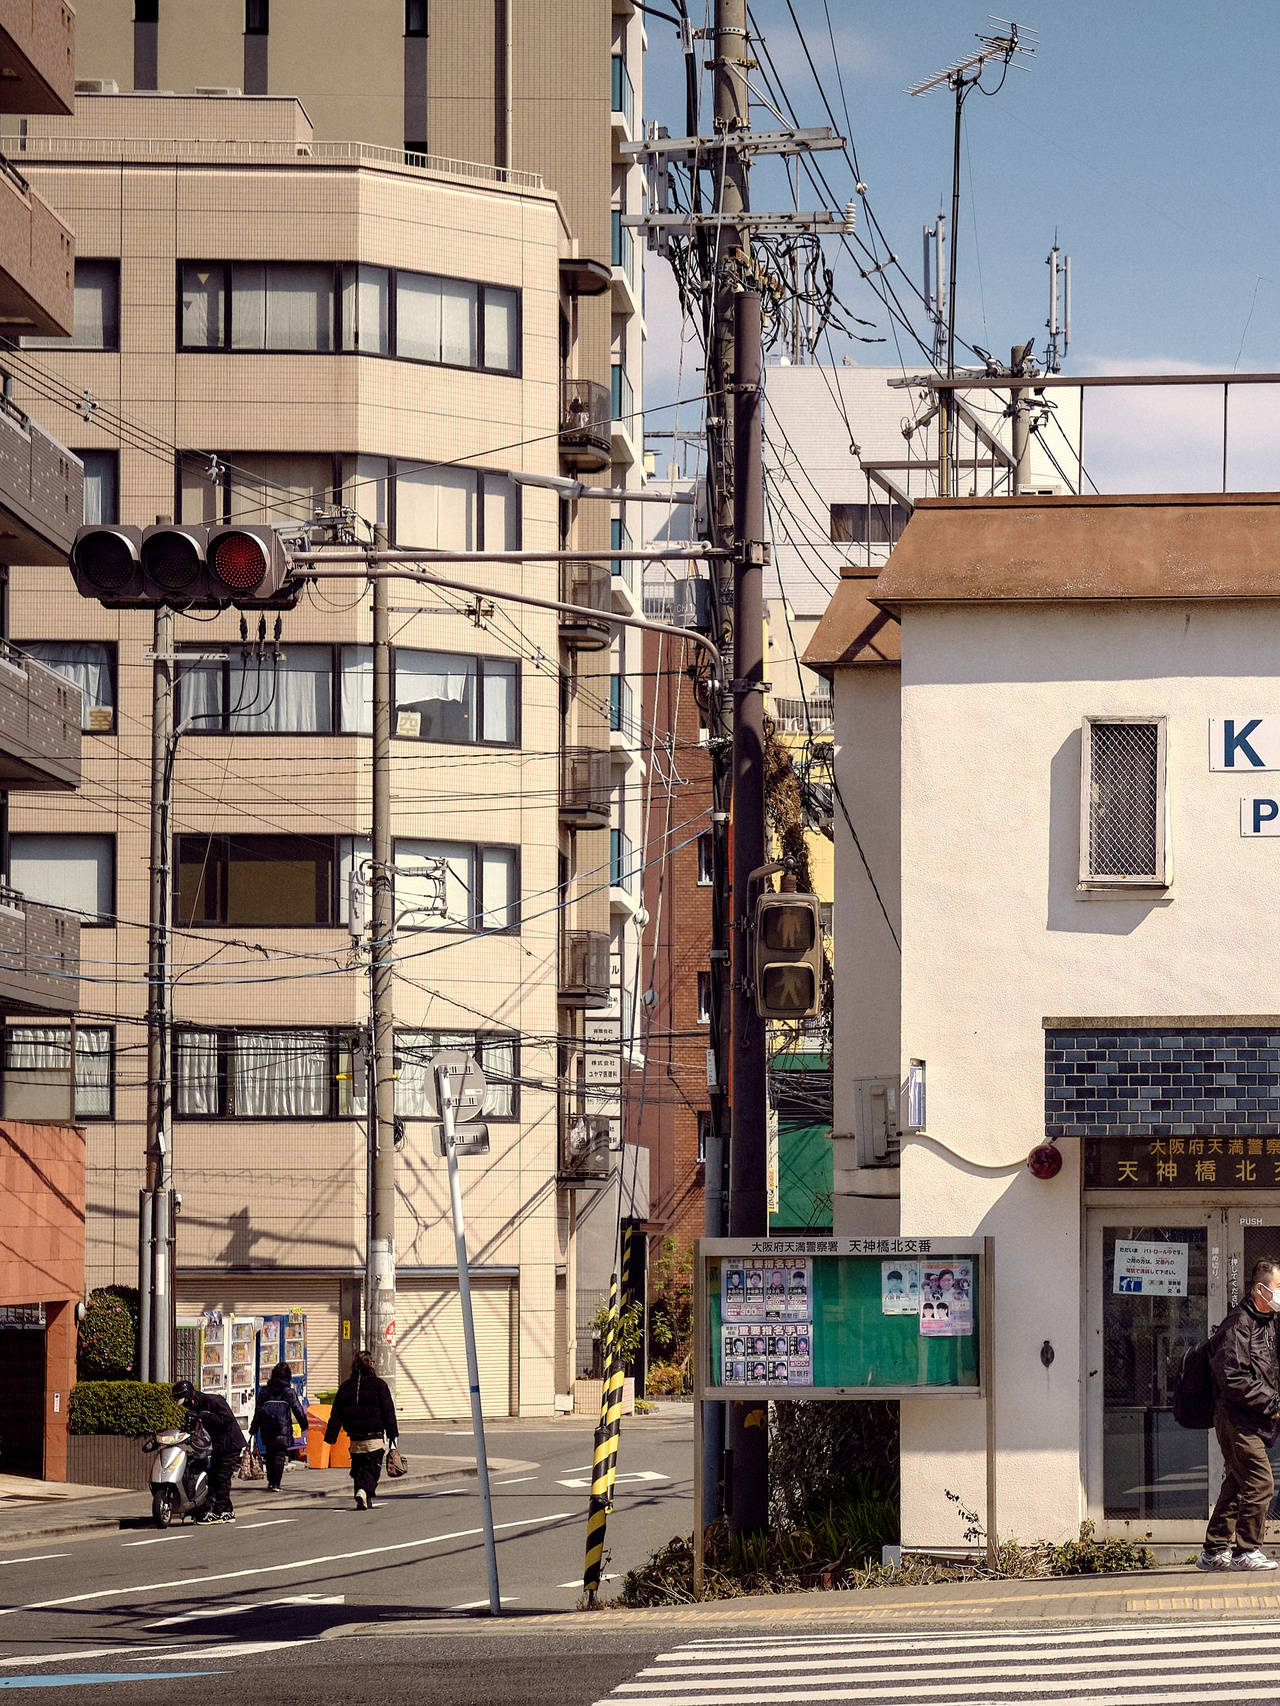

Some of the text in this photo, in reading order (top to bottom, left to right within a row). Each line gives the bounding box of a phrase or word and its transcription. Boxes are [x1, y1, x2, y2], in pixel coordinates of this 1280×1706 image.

[89, 708, 112, 731] 室
[399, 715, 419, 737] 空
[1239, 1217, 1263, 1226] PUSH
[751, 1239, 932, 1253] 大阪府天満警察署 天神橋北交番
[743, 1258, 806, 1270] 重要指名手配
[738, 1325, 808, 1336] 重要指名手配
